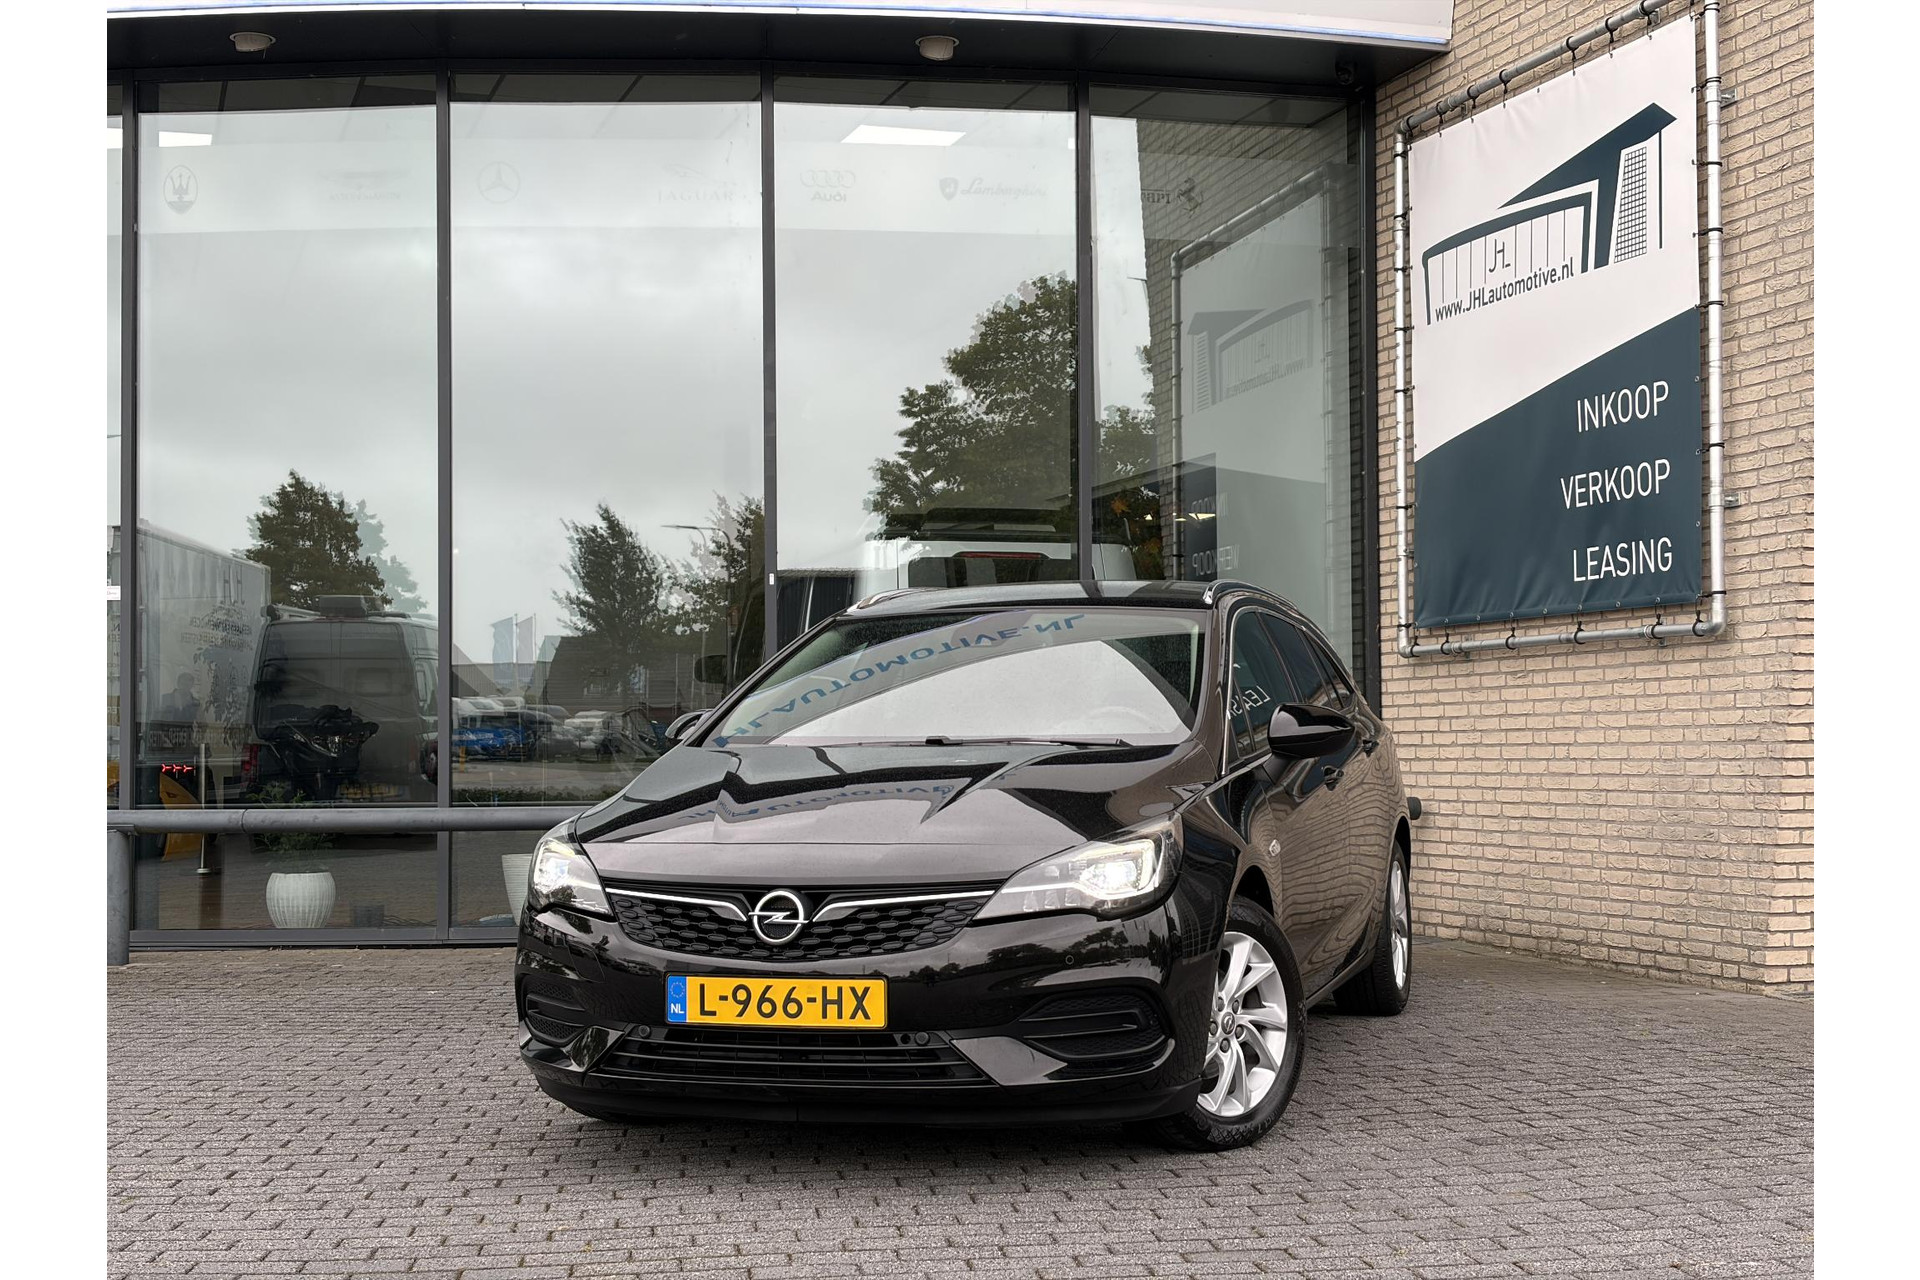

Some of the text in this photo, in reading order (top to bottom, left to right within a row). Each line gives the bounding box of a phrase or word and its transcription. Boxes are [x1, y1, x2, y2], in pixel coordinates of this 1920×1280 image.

[811, 191, 847, 203] Audi
[1488, 239, 1511, 273] JHL
[1435, 256, 1574, 322] www.JHLautomotive.nl
[1576, 381, 1669, 432] INKOOP
[1560, 459, 1670, 509] VERKOOP
[1573, 537, 1672, 582] LEASING
[670, 1003, 685, 1014] NL
[699, 983, 871, 1020] L-966-HX
